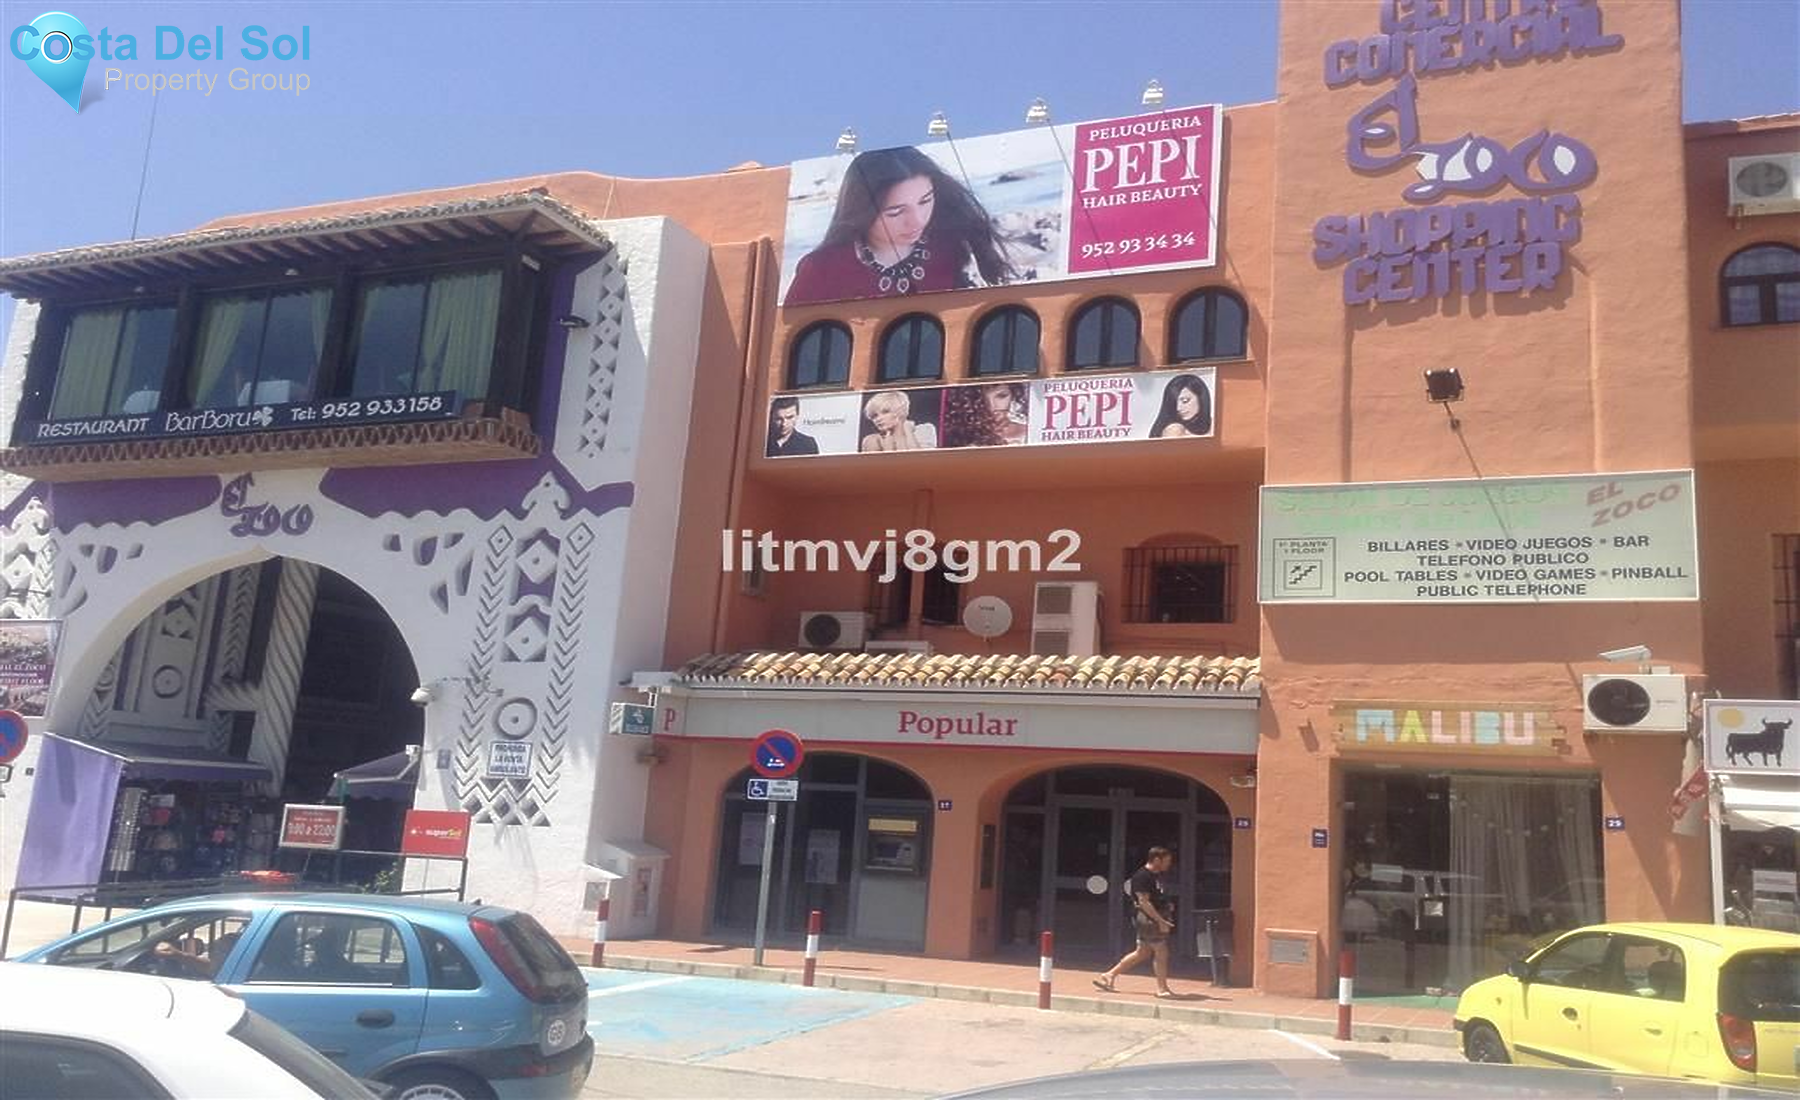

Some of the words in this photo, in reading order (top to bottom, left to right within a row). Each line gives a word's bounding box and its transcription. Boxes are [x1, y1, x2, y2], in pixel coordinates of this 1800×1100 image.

[1324, 7, 1624, 86] COMERCIAL
[1089, 115, 1201, 141] PELUQUERIA
[1080, 134, 1201, 193] PEPI
[1083, 193, 1126, 209] HAIR
[1131, 183, 1203, 203] BEAUTY
[1313, 194, 1581, 268] SHOPPING
[1082, 241, 1114, 258] 952
[1119, 238, 1141, 254] 93
[1145, 234, 1168, 250] 34
[1172, 231, 1195, 248] 34
[1343, 241, 1561, 305] CENTER
[1044, 378, 1134, 393] PELUQUERIA
[37, 417, 149, 437] RESTAURANT
[291, 408, 316, 421] Tel:
[322, 401, 361, 419] 952
[366, 396, 442, 416] 933158
[1042, 390, 1133, 430] PEPI
[1041, 430, 1074, 441] HAIR
[1078, 428, 1131, 439] BEAUTY
[1586, 481, 1624, 505] EL
[1591, 483, 1682, 528] ZOCO
[1368, 540, 1449, 552] BILLARES
[1466, 539, 1517, 551] VIDEO
[1523, 536, 1593, 550] JUEGOS
[1613, 535, 1650, 548] BAR
[1417, 554, 1506, 567] TELEFONO
[1512, 552, 1589, 565] PUBLICO
[1344, 571, 1389, 583] POOL
[1396, 570, 1458, 582] TABLES
[1476, 569, 1528, 581] VIDEO
[1534, 568, 1596, 581] GAMES
[1612, 567, 1688, 579] PINBALL
[1417, 585, 1479, 597] PUBLIC
[1484, 583, 1587, 596] TELEPHONE
[664, 707, 676, 731] P
[898, 711, 1018, 740] Popular
[1356, 710, 1535, 745] MALIBU
